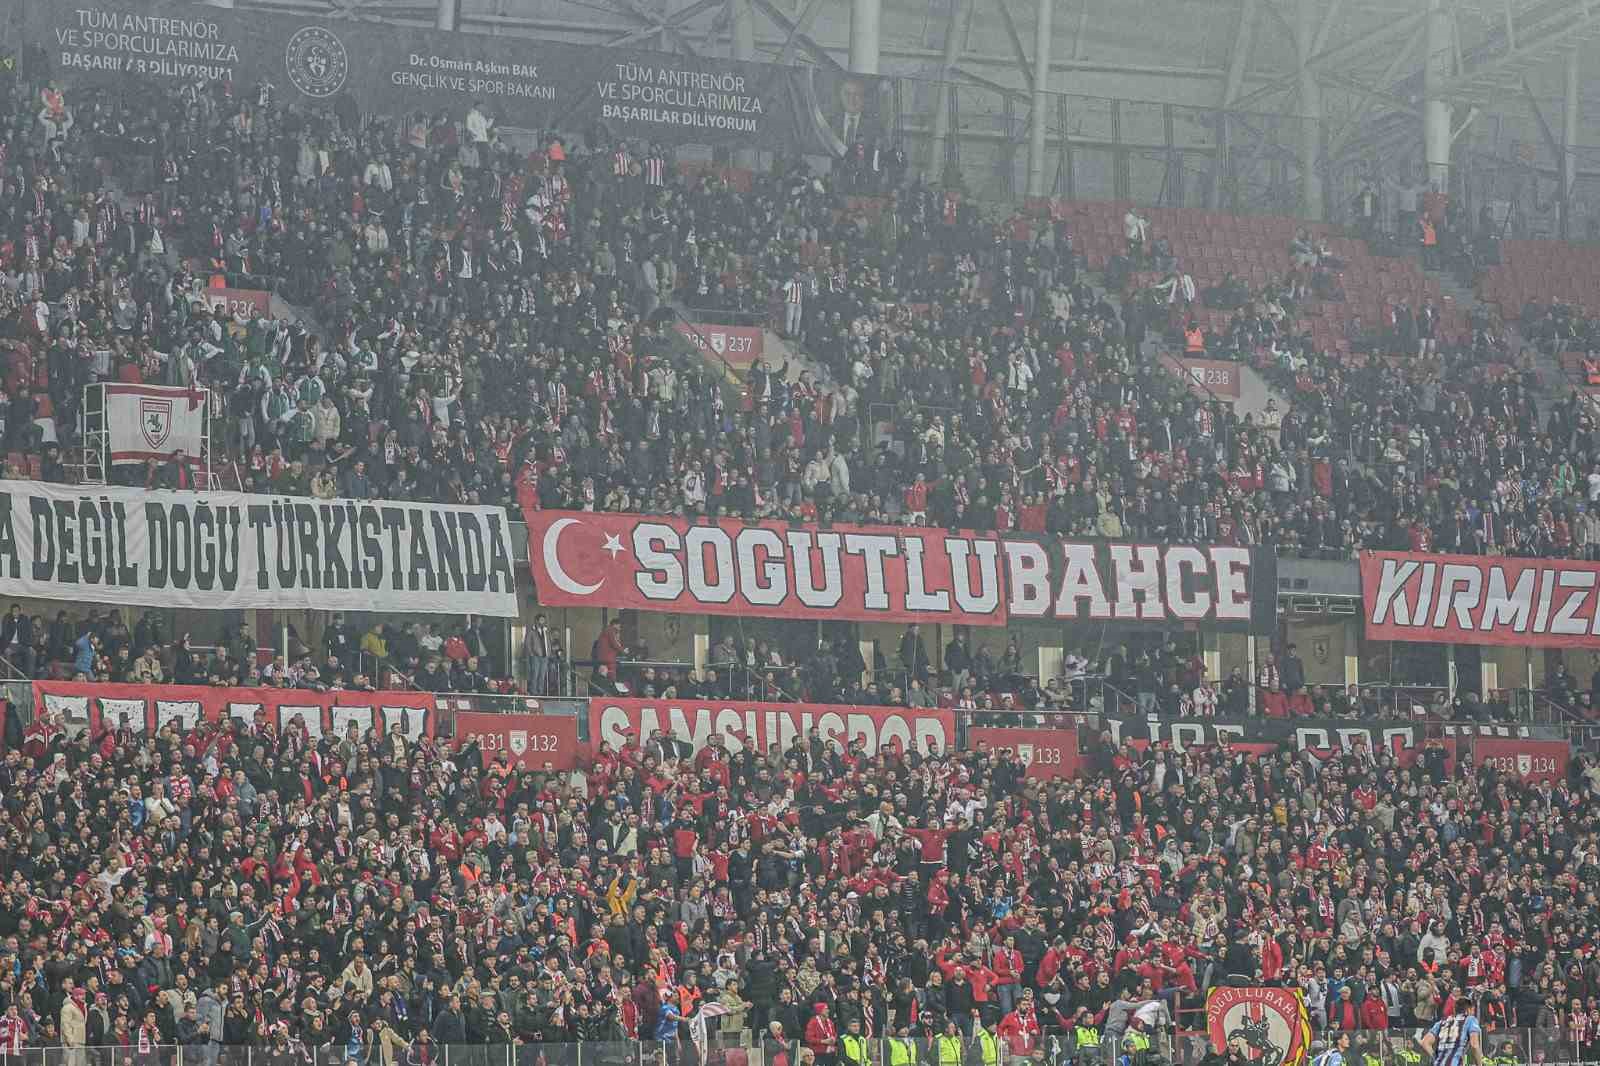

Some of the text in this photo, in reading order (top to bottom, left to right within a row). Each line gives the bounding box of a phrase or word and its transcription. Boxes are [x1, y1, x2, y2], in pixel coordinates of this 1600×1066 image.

[76, 8, 219, 41] TÜM ANTRENÖR
[55, 28, 239, 63] VE SPORCULARIMIZA
[409, 54, 538, 78] Dr. Osman Aşkın BAK
[615, 61, 745, 93] TÜM ANTRENÖR
[391, 71, 557, 100] GENÇLİK VE SPOR BAKANI
[596, 81, 763, 114] VE SPORCULARIMIZA
[602, 104, 757, 132] BAŞARILAR DİLİYORUM
[728, 336, 752, 353] 237
[1207, 368, 1230, 385] 238
[28, 495, 139, 588] DEĞİL
[144, 500, 241, 592] DOĞU
[247, 498, 515, 594] TÜRKİSTANDA
[479, 733, 558, 752] 131 132
[1035, 748, 1061, 765] 133
[1533, 758, 1556, 774] 134
